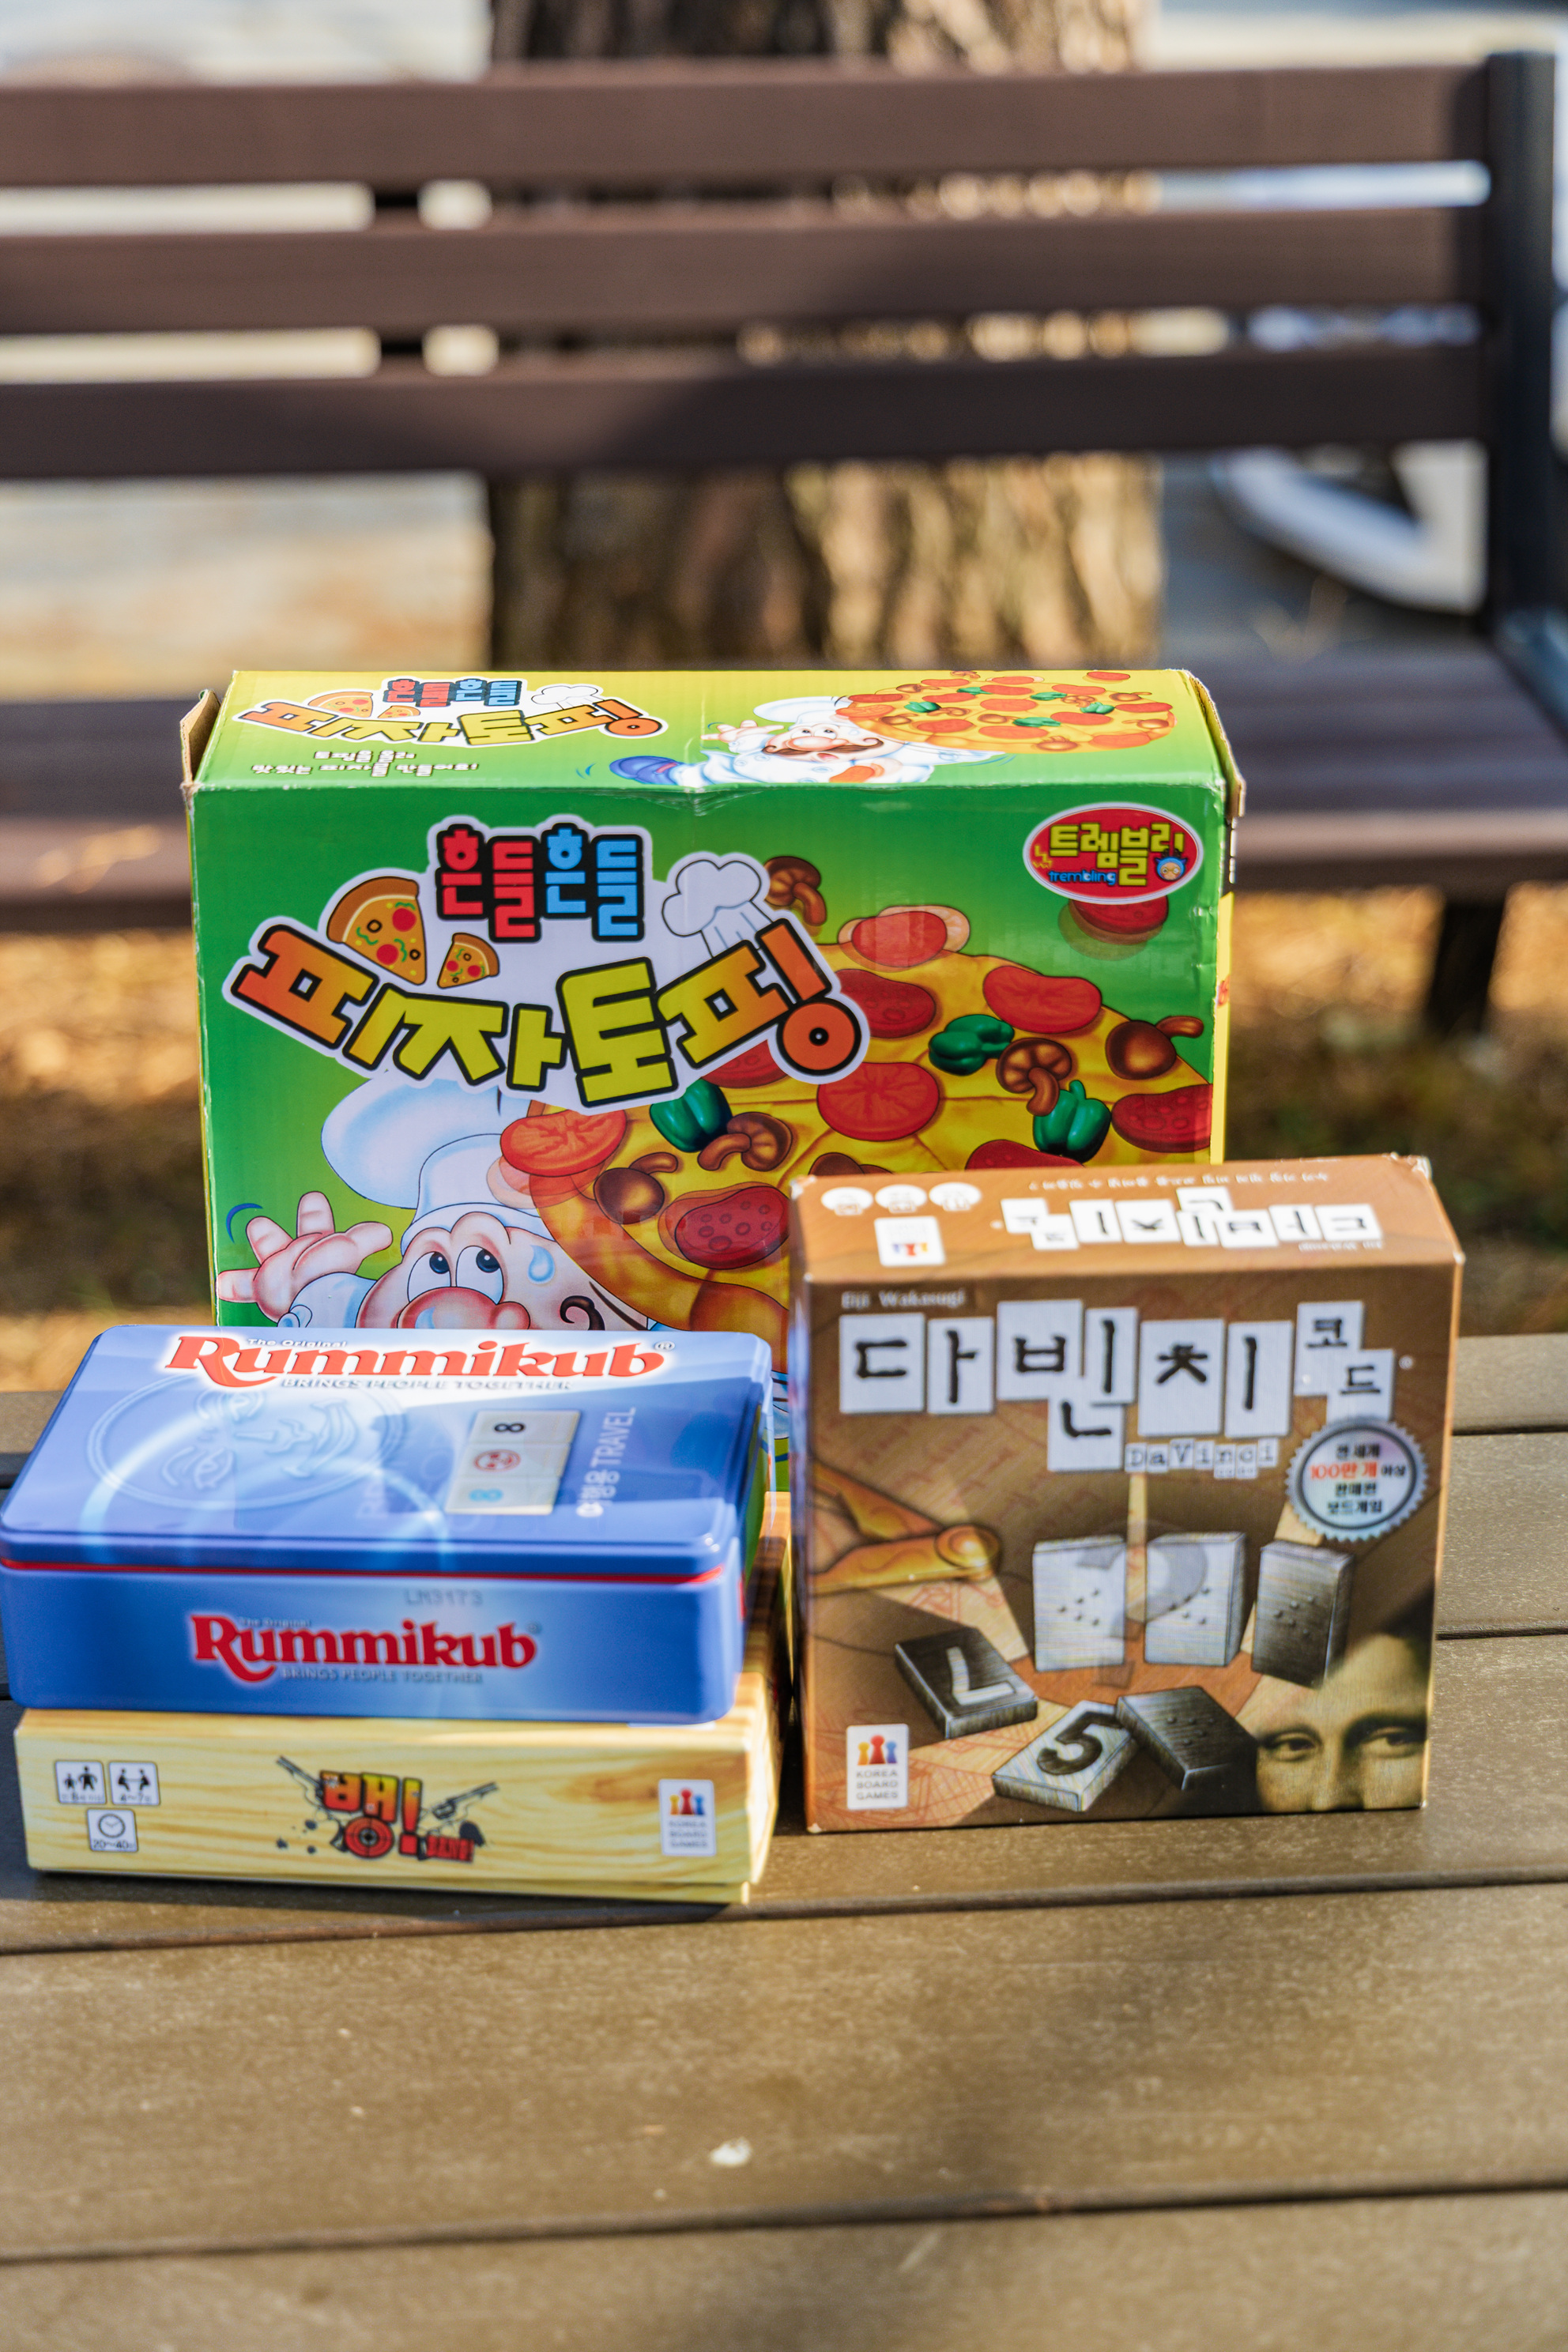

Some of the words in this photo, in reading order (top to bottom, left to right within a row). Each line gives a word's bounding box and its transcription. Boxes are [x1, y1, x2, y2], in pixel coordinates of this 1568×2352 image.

[382, 678, 522, 707] 흔들흔들
[238, 699, 663, 745] 피자토핑
[314, 750, 372, 763] 토핑을
[318, 762, 390, 777] 피자를
[1049, 823, 1185, 886] 트렘블리
[435, 824, 646, 943] 흔들흔들
[1048, 870, 1117, 886] trembling
[231, 917, 863, 1107] 피자토핑
[282, 1339, 347, 1348] Original
[164, 1335, 665, 1388] Rummikub
[282, 1378, 361, 1389] BRINGS
[855, 1319, 1260, 1438] 다빈치
[1306, 1317, 1381, 1395] 코드
[590, 1407, 635, 1468] TRAVEL
[190, 1614, 537, 1682] Rummikub
[856, 1770, 898, 1778] KOREA
[856, 1780, 898, 1789] BOARD
[856, 1791, 898, 1800] GAMES
